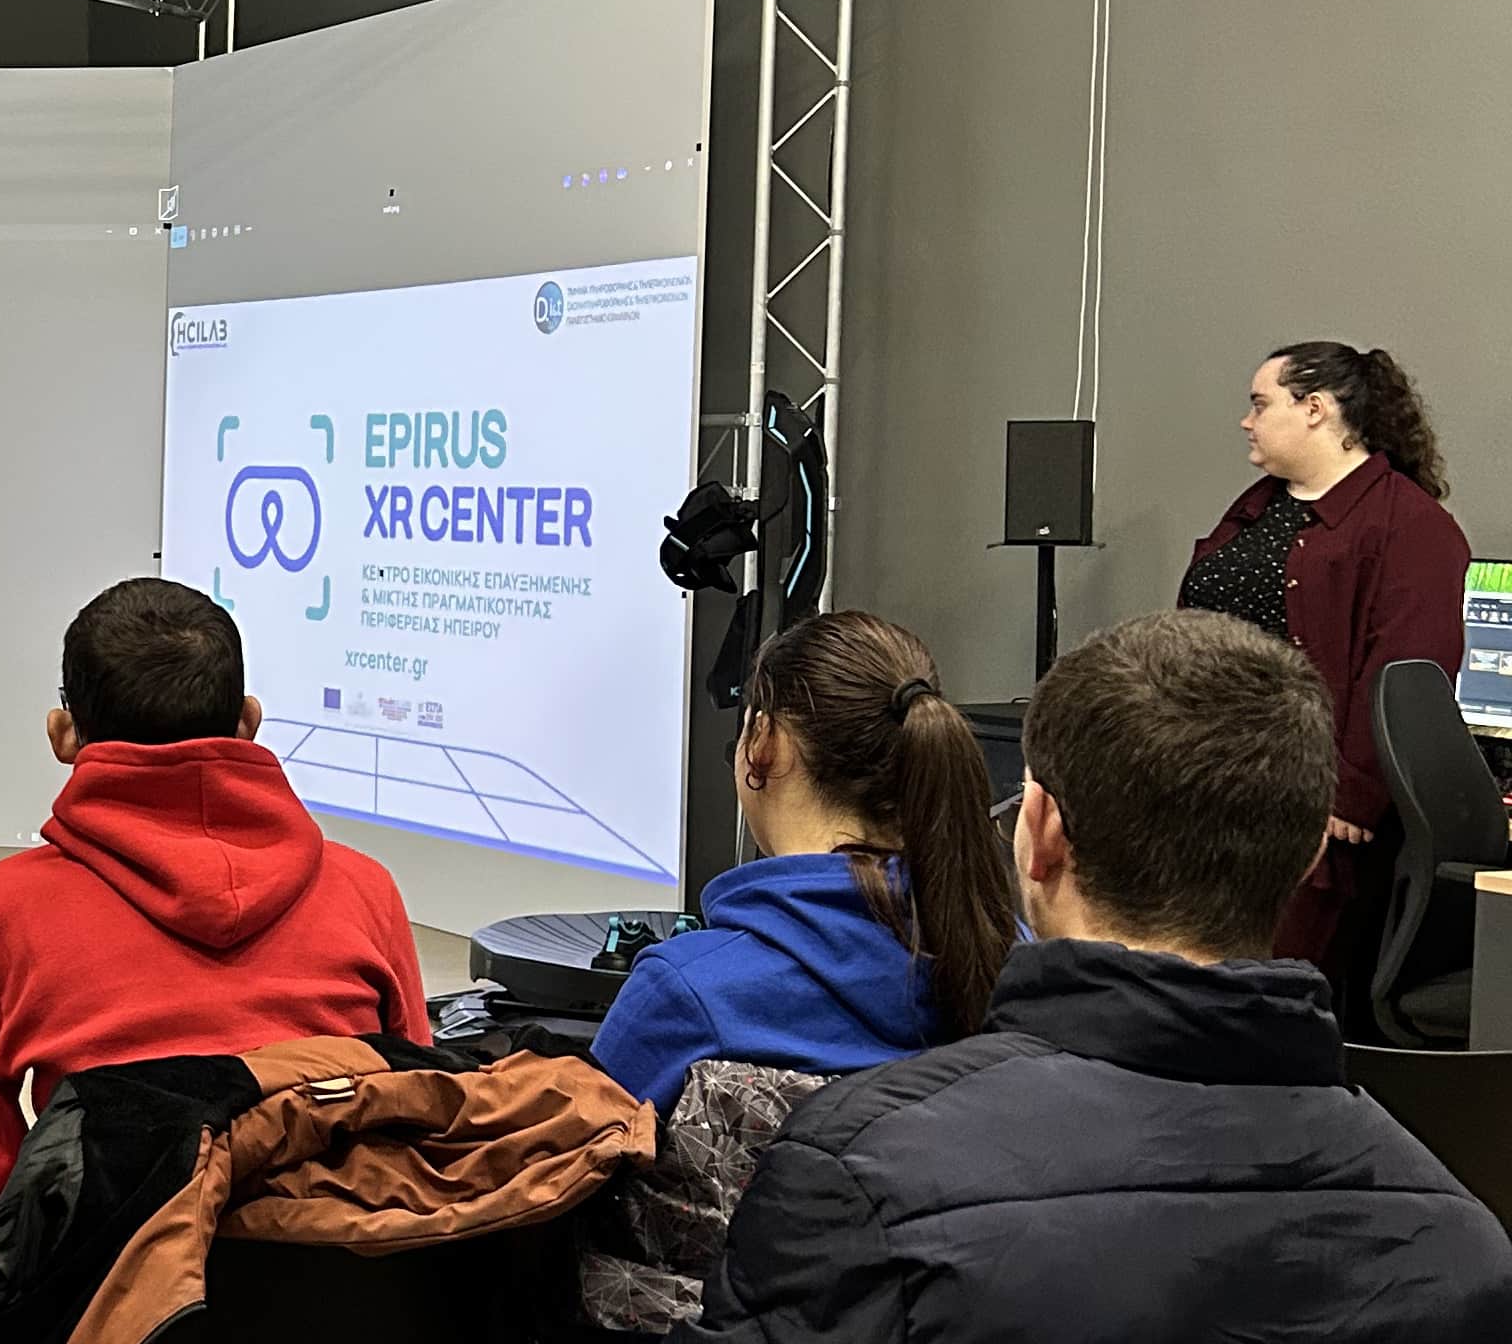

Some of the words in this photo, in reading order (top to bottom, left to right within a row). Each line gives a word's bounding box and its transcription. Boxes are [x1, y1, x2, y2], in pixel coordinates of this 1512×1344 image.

[365, 409, 508, 469] EPIRUS
[364, 485, 413, 539] XR
[420, 485, 593, 547] CENTER
[413, 567, 481, 589] ΕΙΚΟΝΙΚΗΣ
[484, 571, 592, 596] ΕΠΑΥΞΗΜΕΝΗΣ
[361, 588, 370, 604] &
[373, 589, 419, 608] ΜΙΚΤΗΣ
[422, 592, 552, 619] ΠΡΑΓΜΑΤΙΚΟΤΗΤΑΣ
[361, 610, 440, 634] ΠΕΡΙΦΕΡΕΙΑΣ
[443, 618, 501, 639] ΗΠΕΙΡΟΥ
[345, 649, 428, 681] xrcenter.gr
